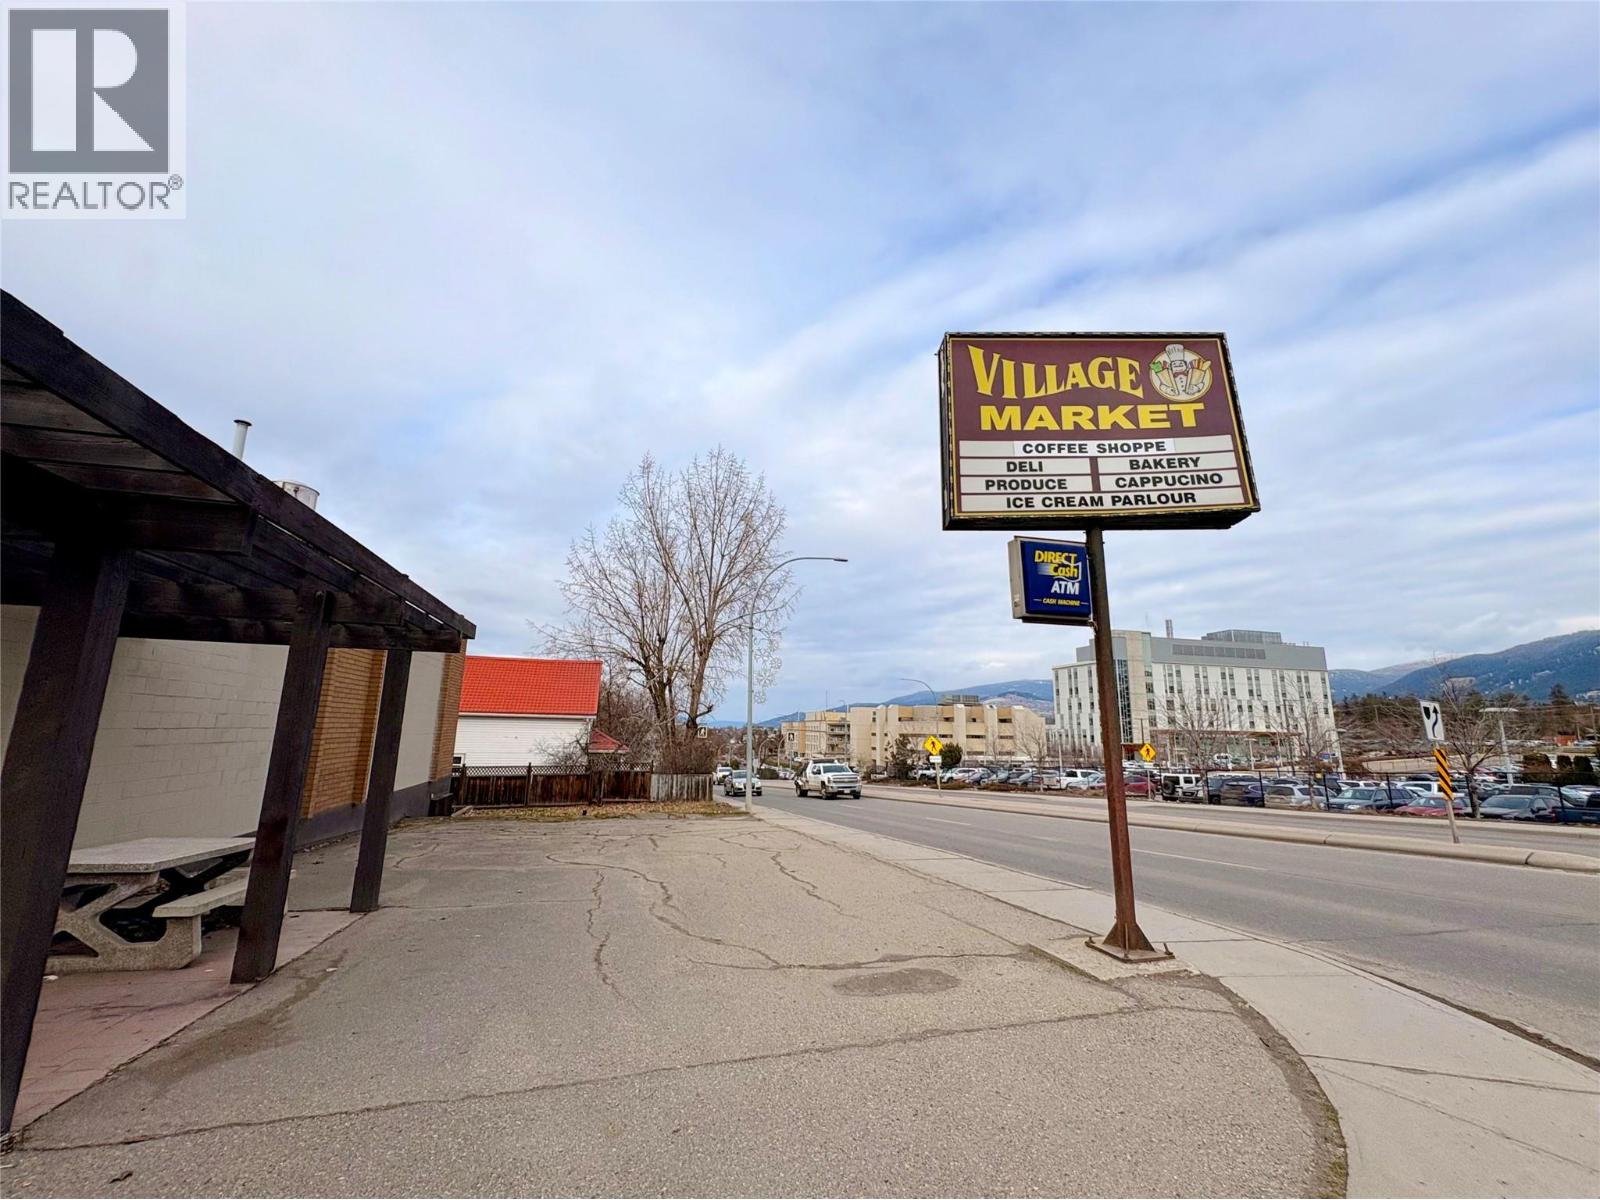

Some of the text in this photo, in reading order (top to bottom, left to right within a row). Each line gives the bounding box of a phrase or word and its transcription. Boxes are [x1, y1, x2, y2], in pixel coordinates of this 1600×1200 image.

[967, 344, 1144, 399] VILLAGE
[980, 403, 1204, 431] MARKET
[1022, 441, 1167, 454] COFFEE SHOPPE
[1006, 461, 1043, 473] DELI
[1129, 457, 1201, 471] BAKERY
[985, 479, 1068, 491] PRODUCE
[1115, 473, 1223, 488] CAPPUCINO
[1006, 493, 1197, 509] ICE CREAM PARLOUR
[1034, 550, 1077, 564] DIRECT
[1049, 563, 1078, 578] Cash
[1051, 580, 1080, 595] ATM
